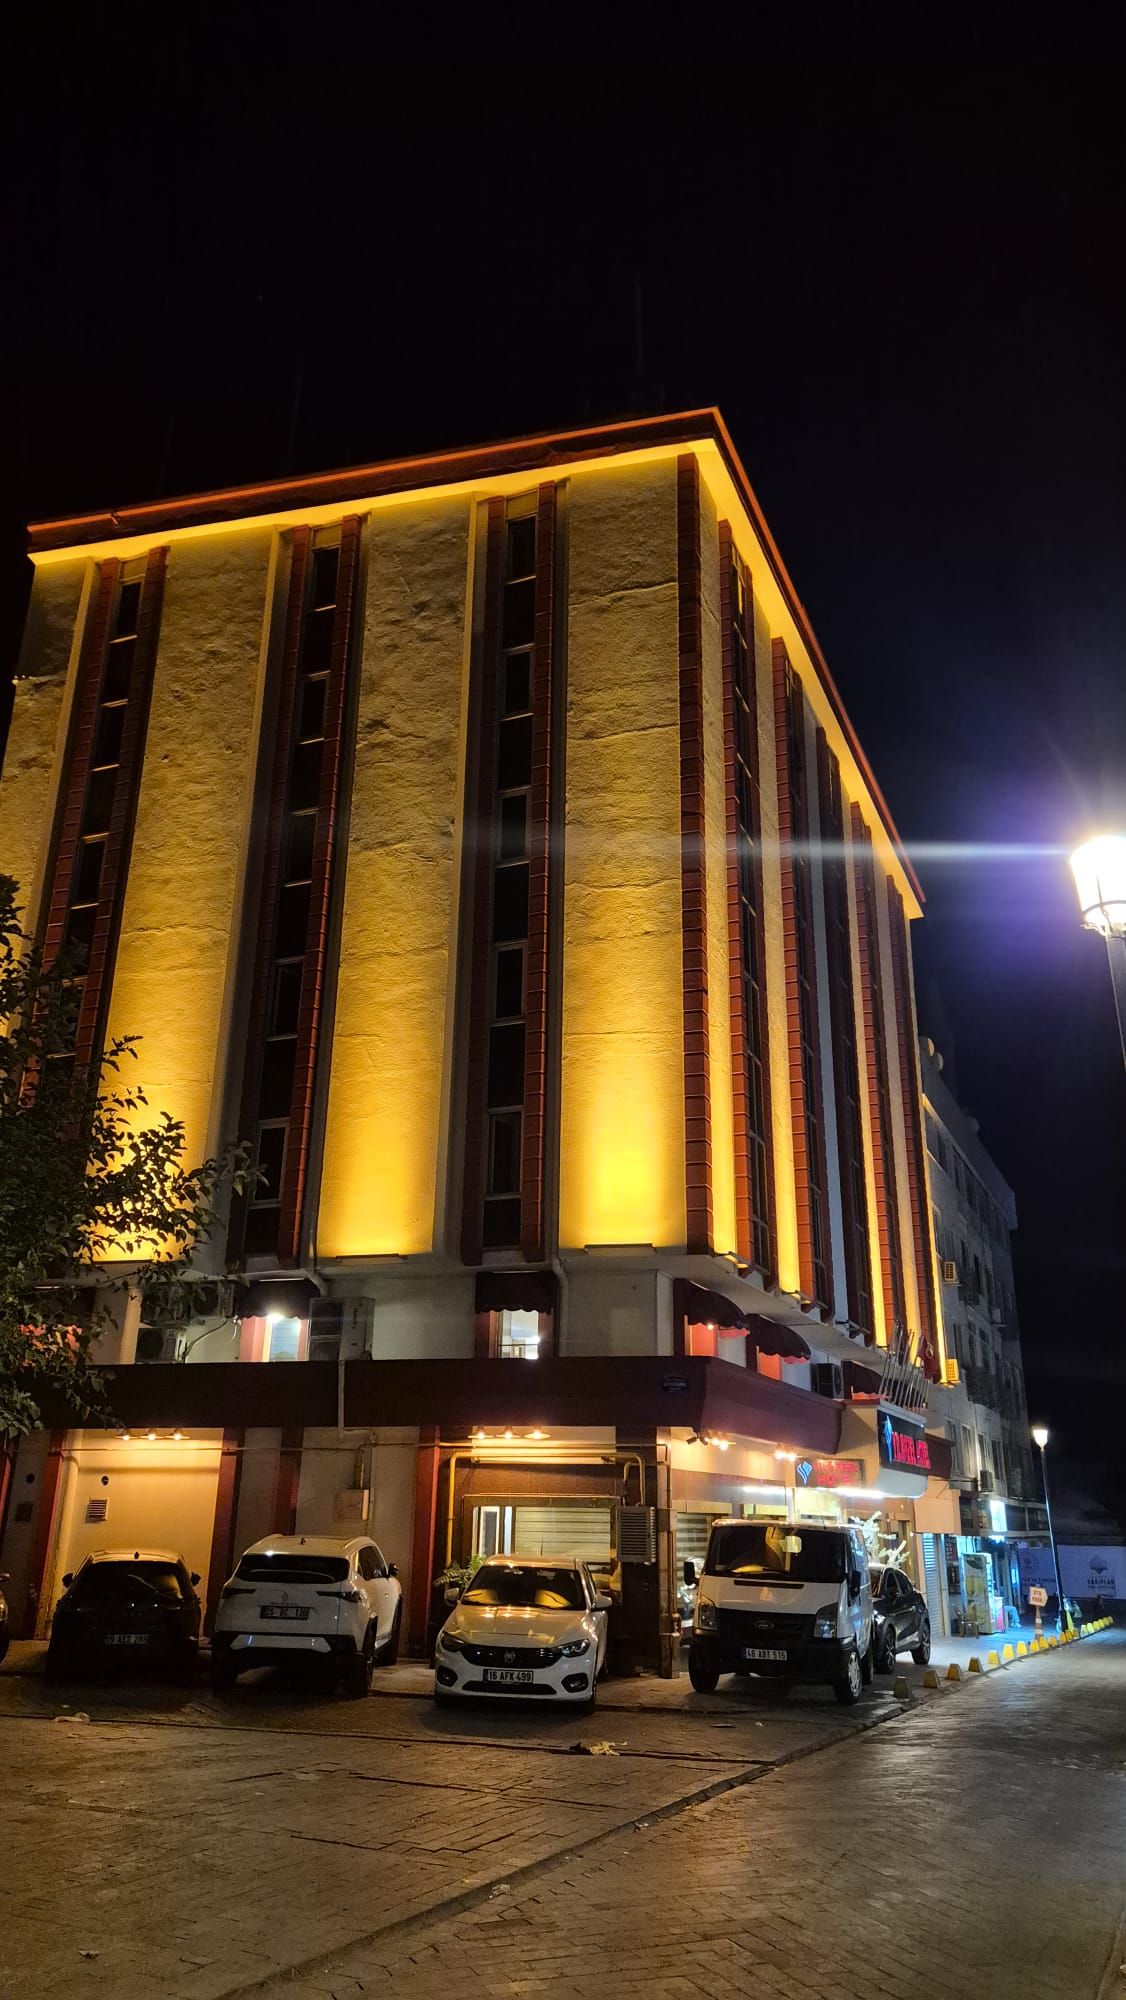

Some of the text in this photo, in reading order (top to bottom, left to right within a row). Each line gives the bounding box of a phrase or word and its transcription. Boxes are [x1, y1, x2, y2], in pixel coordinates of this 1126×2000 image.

[489, 1671, 531, 1682] 16 AFK 499
